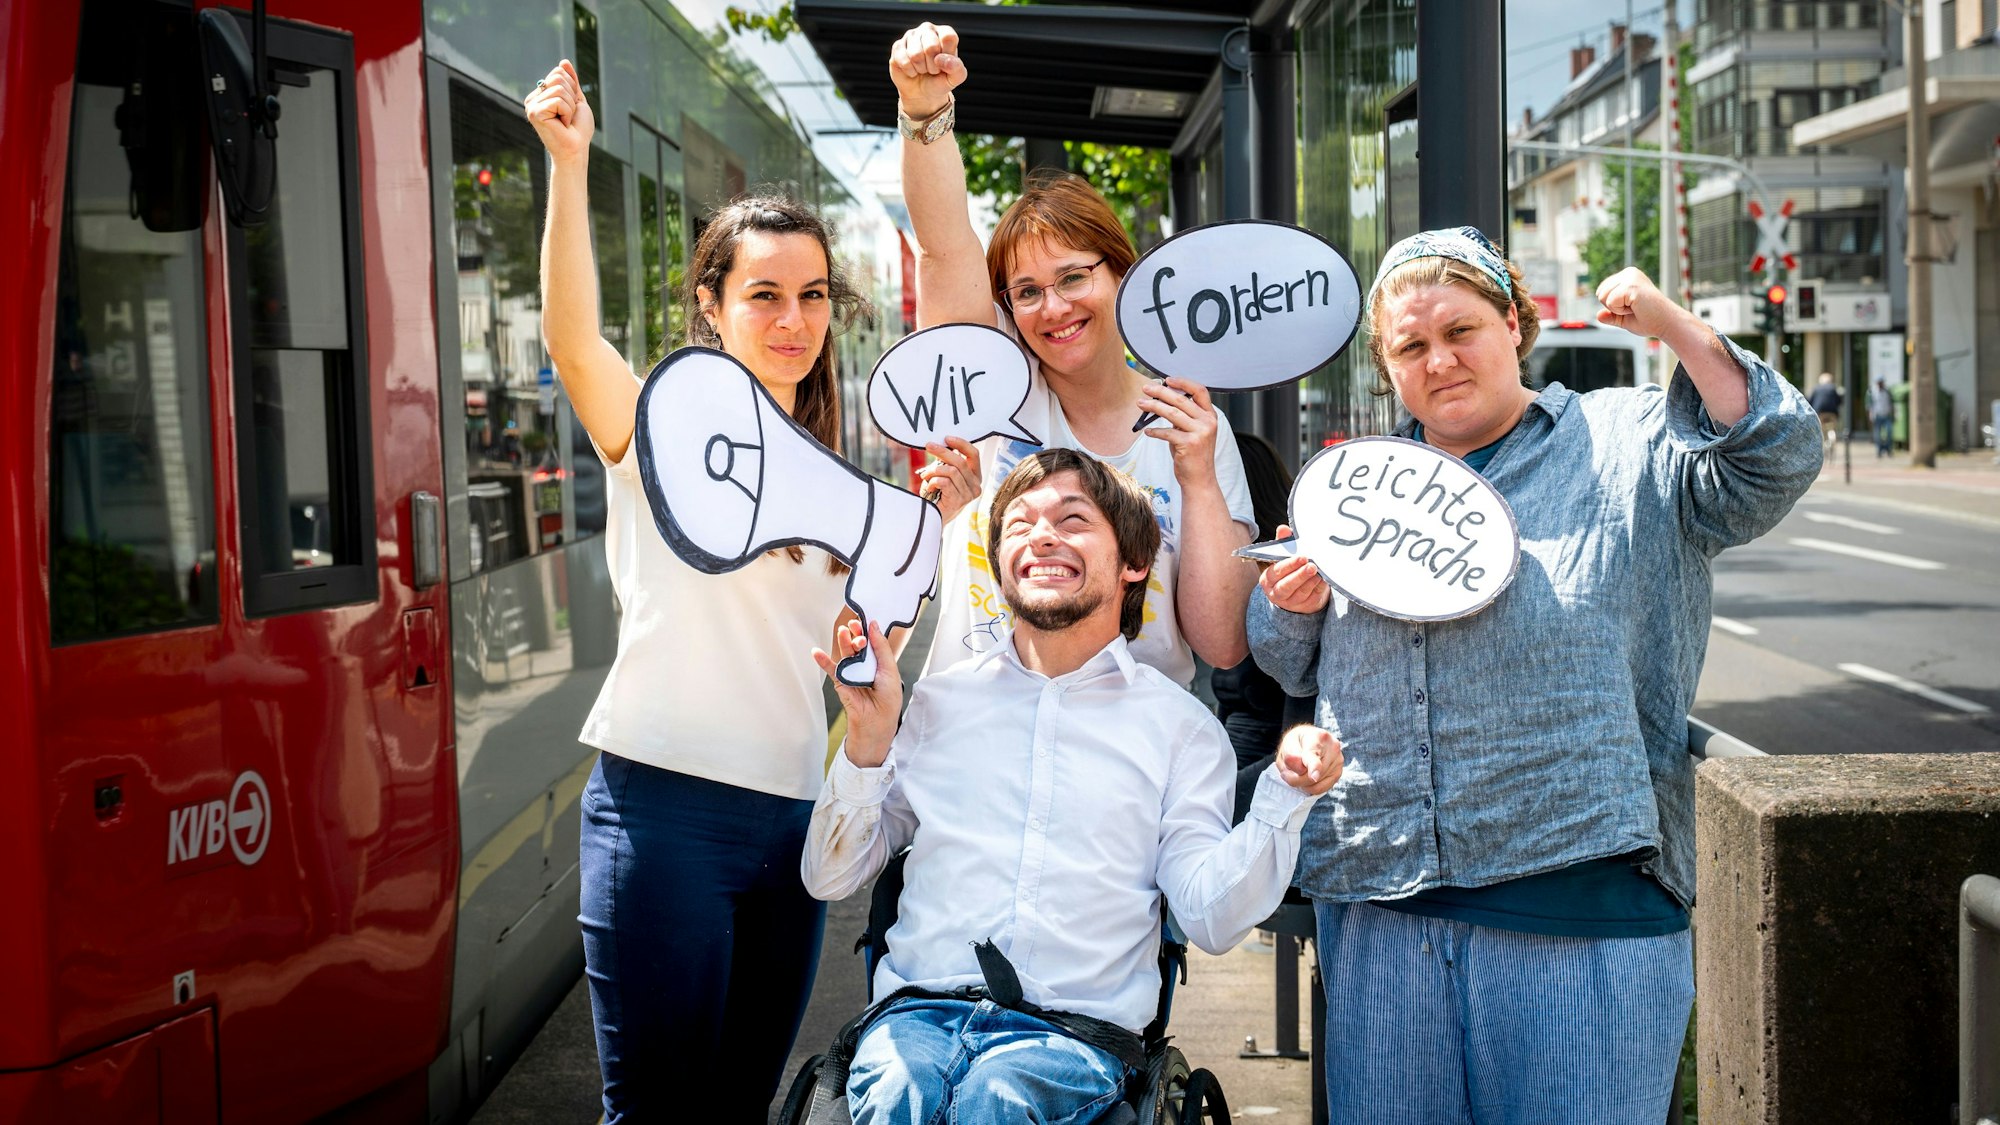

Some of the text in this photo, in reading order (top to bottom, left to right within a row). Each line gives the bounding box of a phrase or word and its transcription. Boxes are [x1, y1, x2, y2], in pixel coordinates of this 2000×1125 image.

[1142, 266, 1330, 354] fordern
[883, 353, 986, 433] Wir
[1328, 495, 1486, 592] Sprache
[167, 799, 227, 866] KVB
